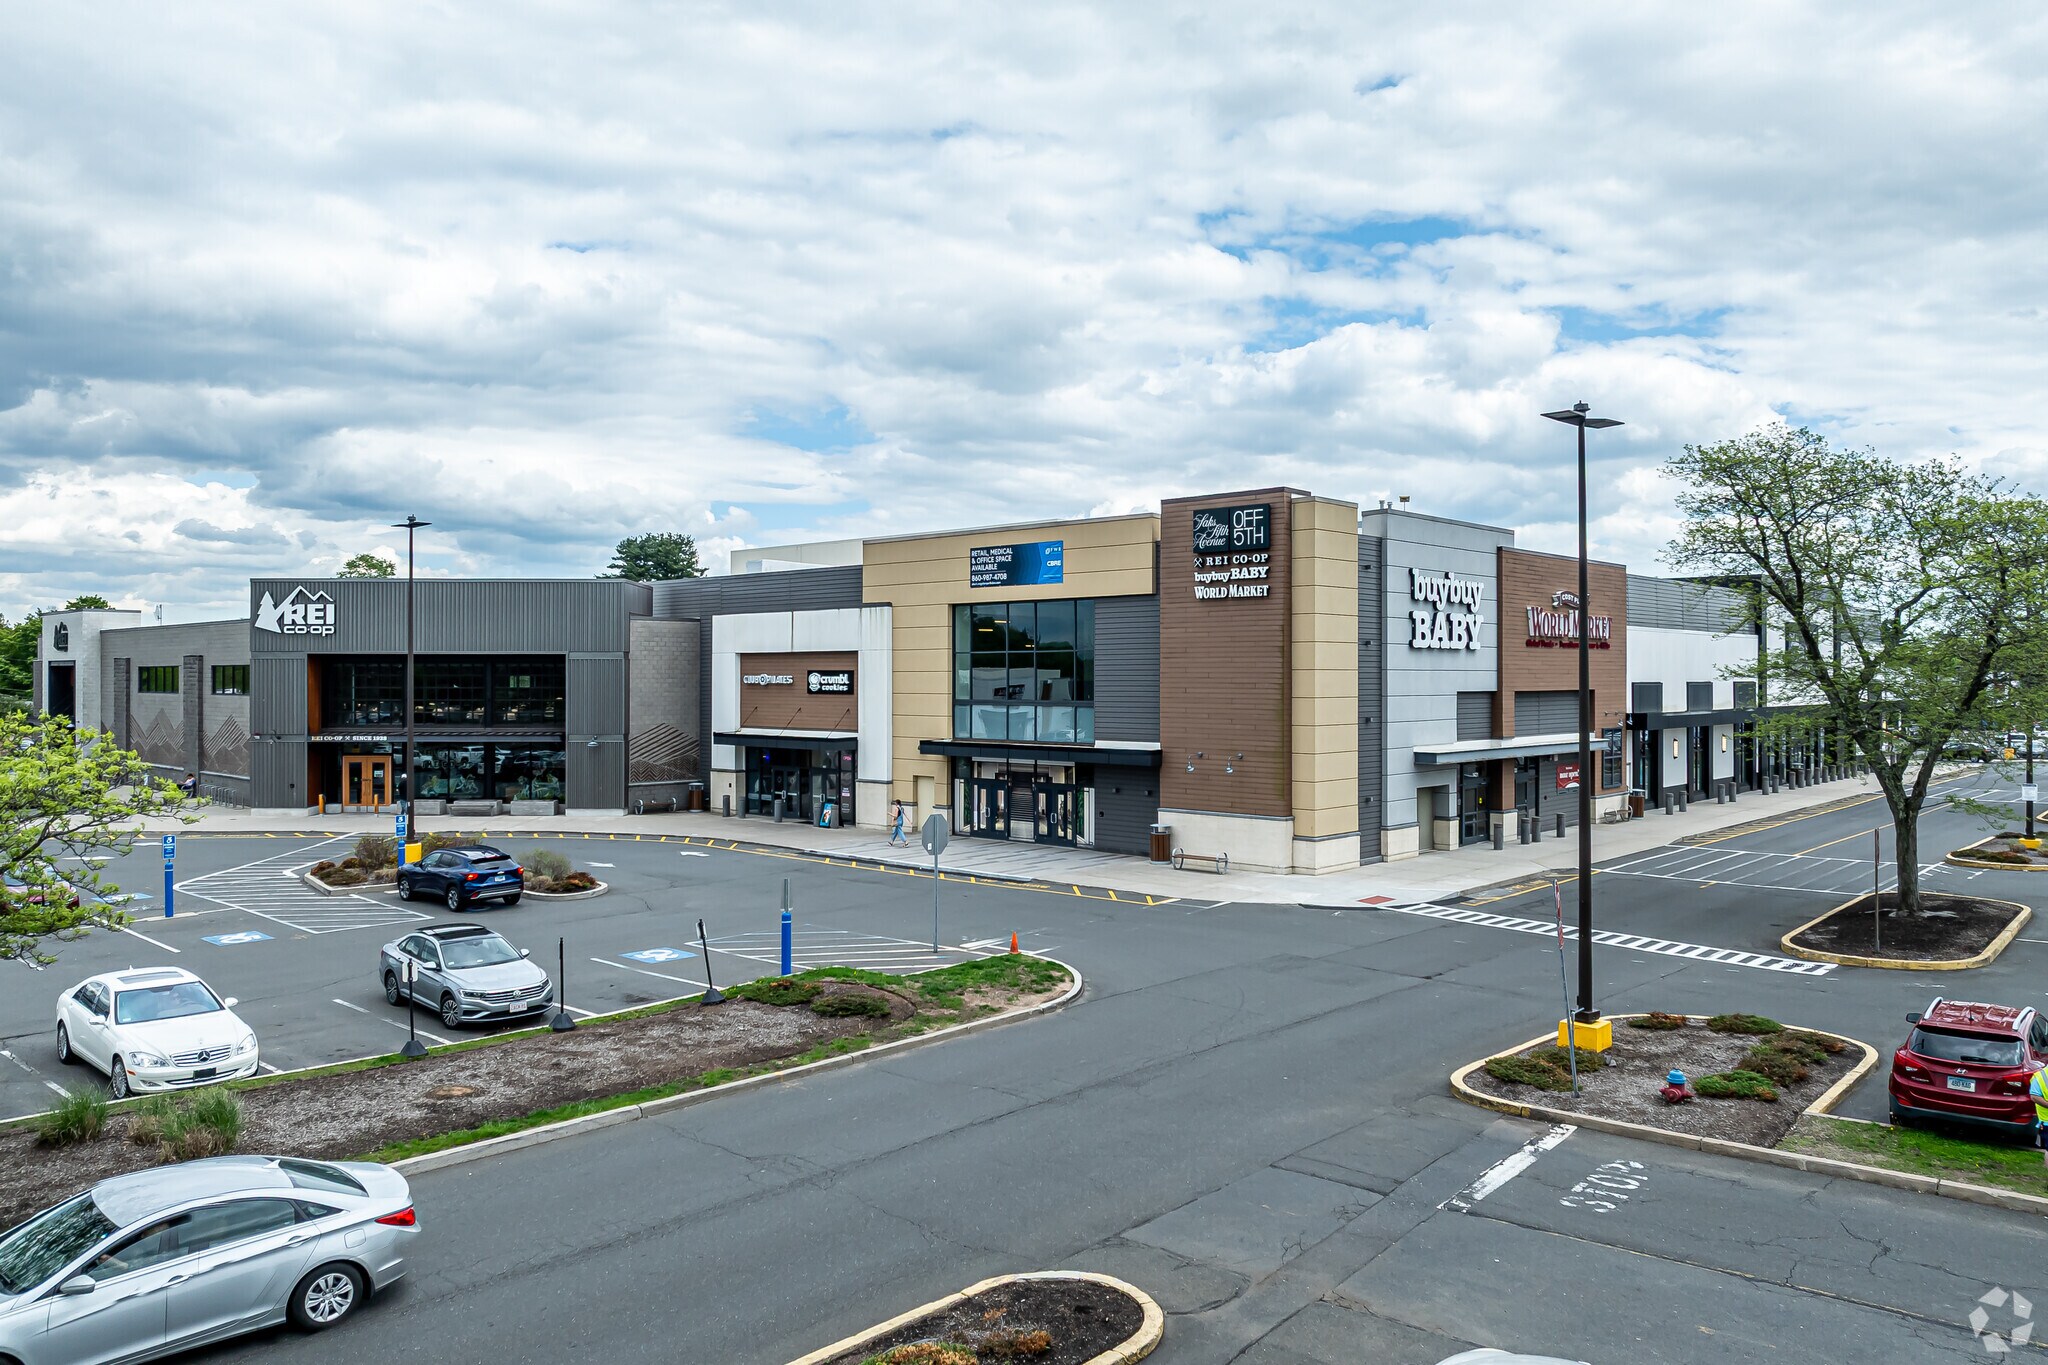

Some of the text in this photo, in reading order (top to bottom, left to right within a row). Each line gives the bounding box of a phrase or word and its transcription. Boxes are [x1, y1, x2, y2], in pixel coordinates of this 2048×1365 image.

[1193, 513, 1217, 531] Saks
[1233, 508, 1264, 528] OFF
[1193, 532, 1226, 549] Avenue
[1233, 526, 1264, 546] 5TH
[990, 547, 1013, 556] MEDICAL
[995, 554, 1012, 563] SPACE
[1206, 553, 1269, 566] REI CO-OP
[971, 563, 998, 572] AVAILABLE
[971, 573, 1008, 582] 860-987-4708
[1411, 568, 1485, 613] buybuy
[1561, 593, 1574, 602] COST
[284, 603, 335, 625] REI
[1411, 610, 1485, 650] BABY
[820, 673, 850, 684] crumbl
